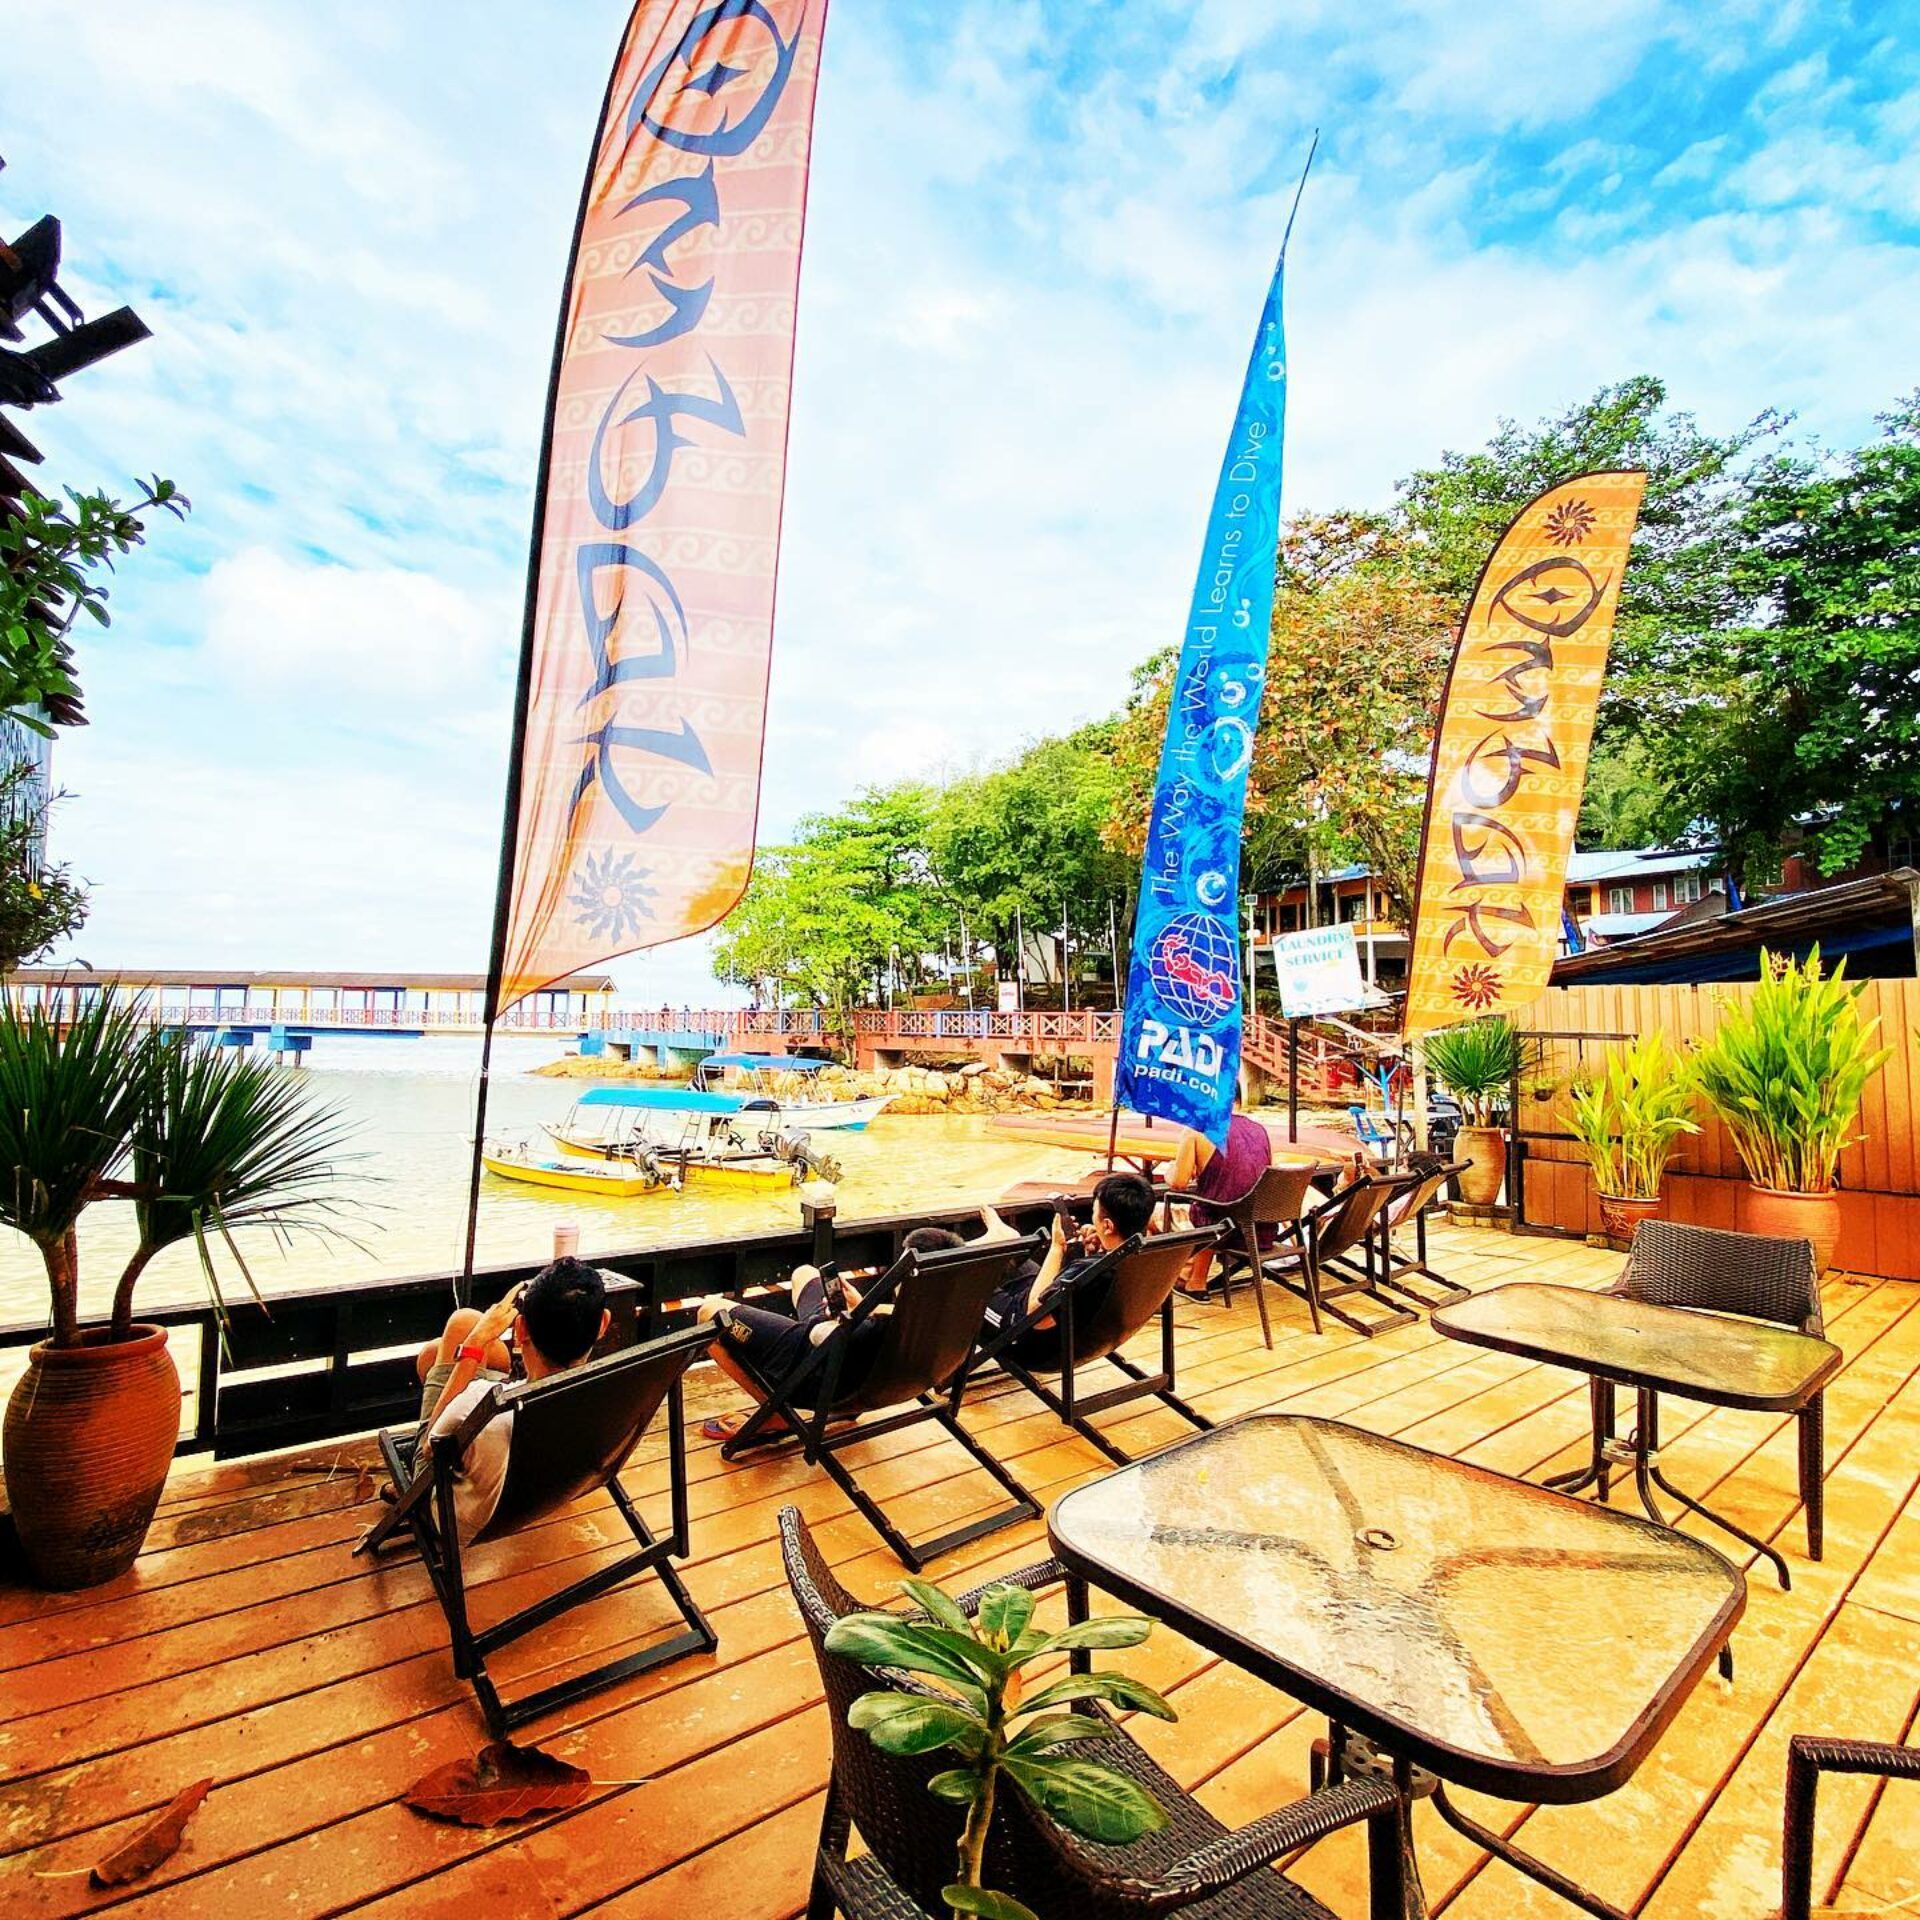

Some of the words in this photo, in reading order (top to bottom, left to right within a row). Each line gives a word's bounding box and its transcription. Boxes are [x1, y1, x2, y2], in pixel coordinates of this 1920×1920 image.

[1229, 421, 1267, 482] Dive
[1225, 493, 1250, 519] to
[1200, 529, 1242, 614] Learns
[1180, 626, 1218, 712] World
[1171, 723, 1202, 762] the
[1160, 771, 1198, 840] Way
[1151, 851, 1180, 896] The
[1280, 931, 1346, 952] LAUNDRY
[1286, 949, 1343, 966] SERVICE
[1136, 1019, 1225, 1084] PADI
